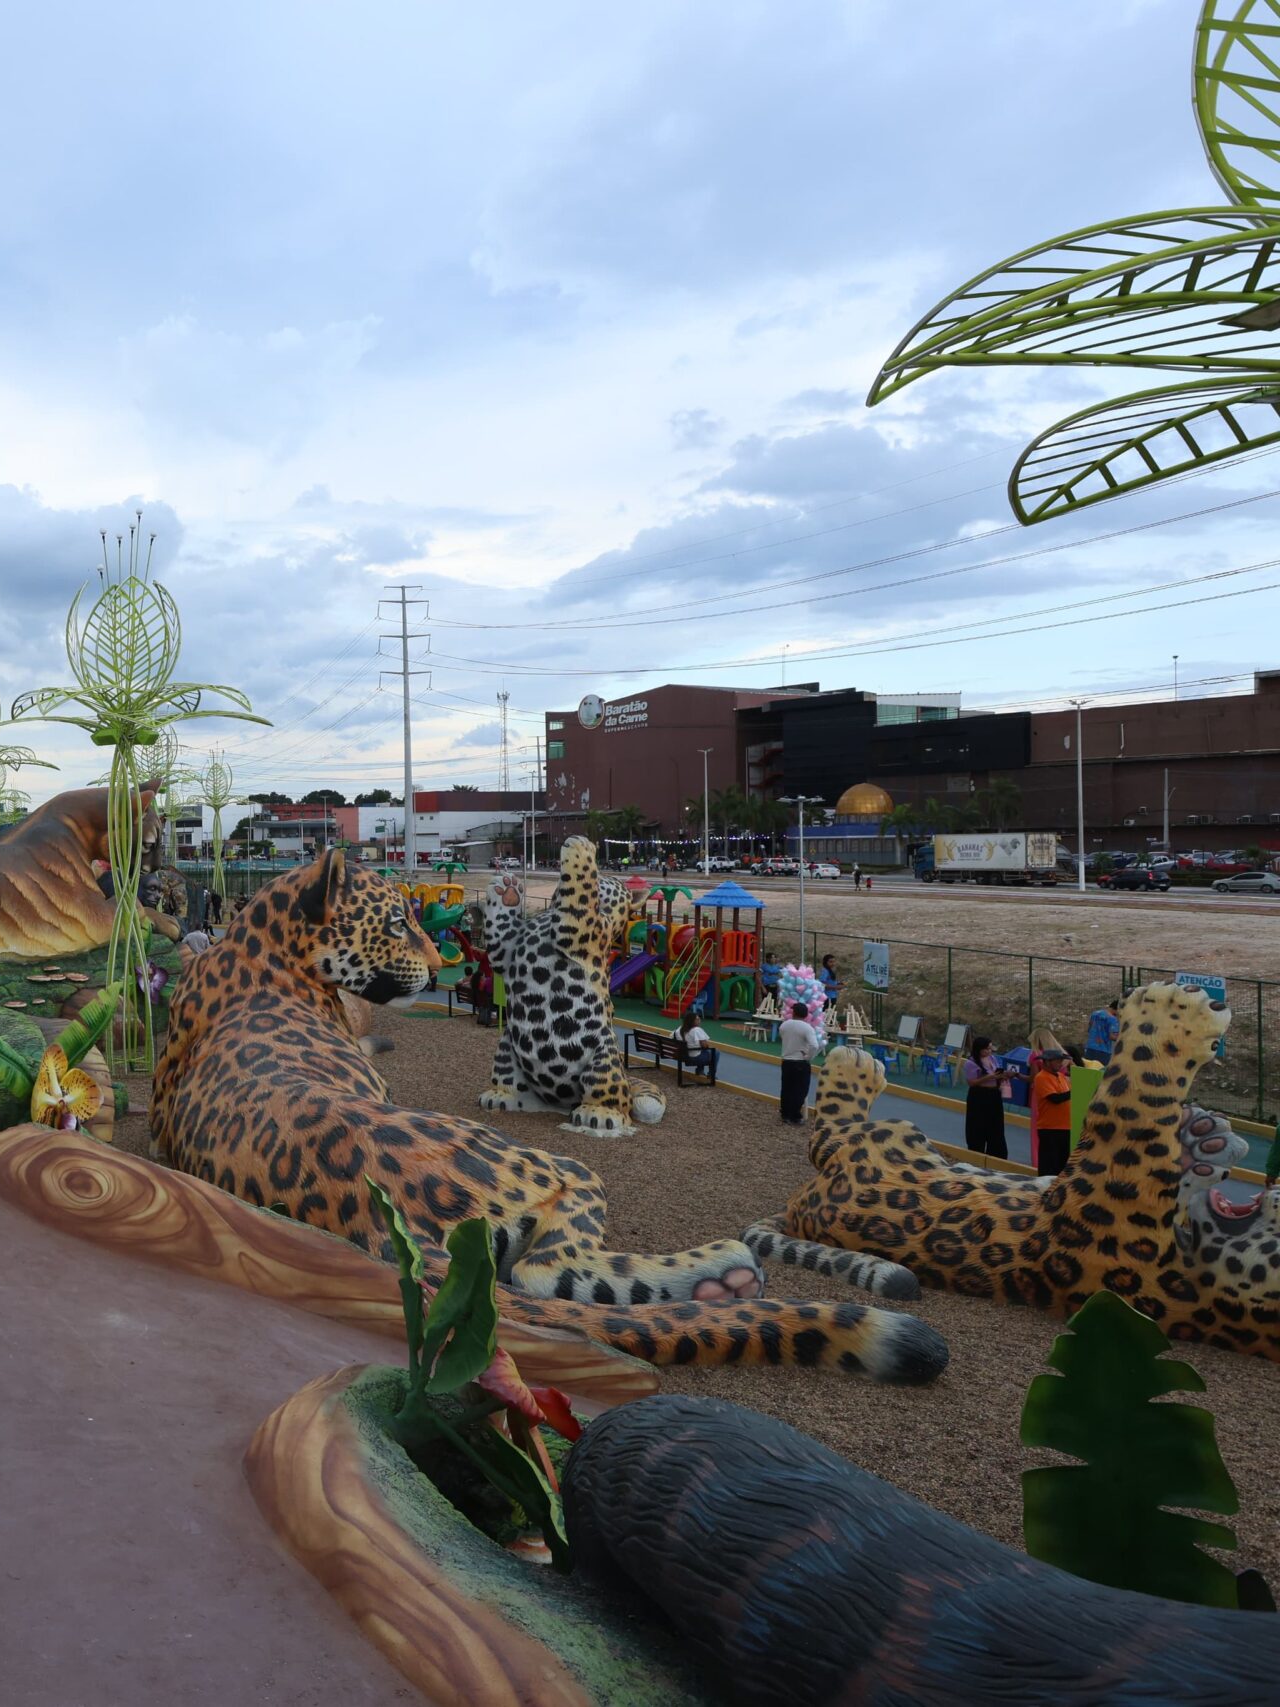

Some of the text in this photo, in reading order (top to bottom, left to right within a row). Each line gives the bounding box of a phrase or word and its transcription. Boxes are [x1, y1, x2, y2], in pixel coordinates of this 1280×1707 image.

[605, 701, 648, 716] Baratão
[605, 713, 648, 726] da Carne
[1179, 975, 1222, 987] ATENÇÃO
